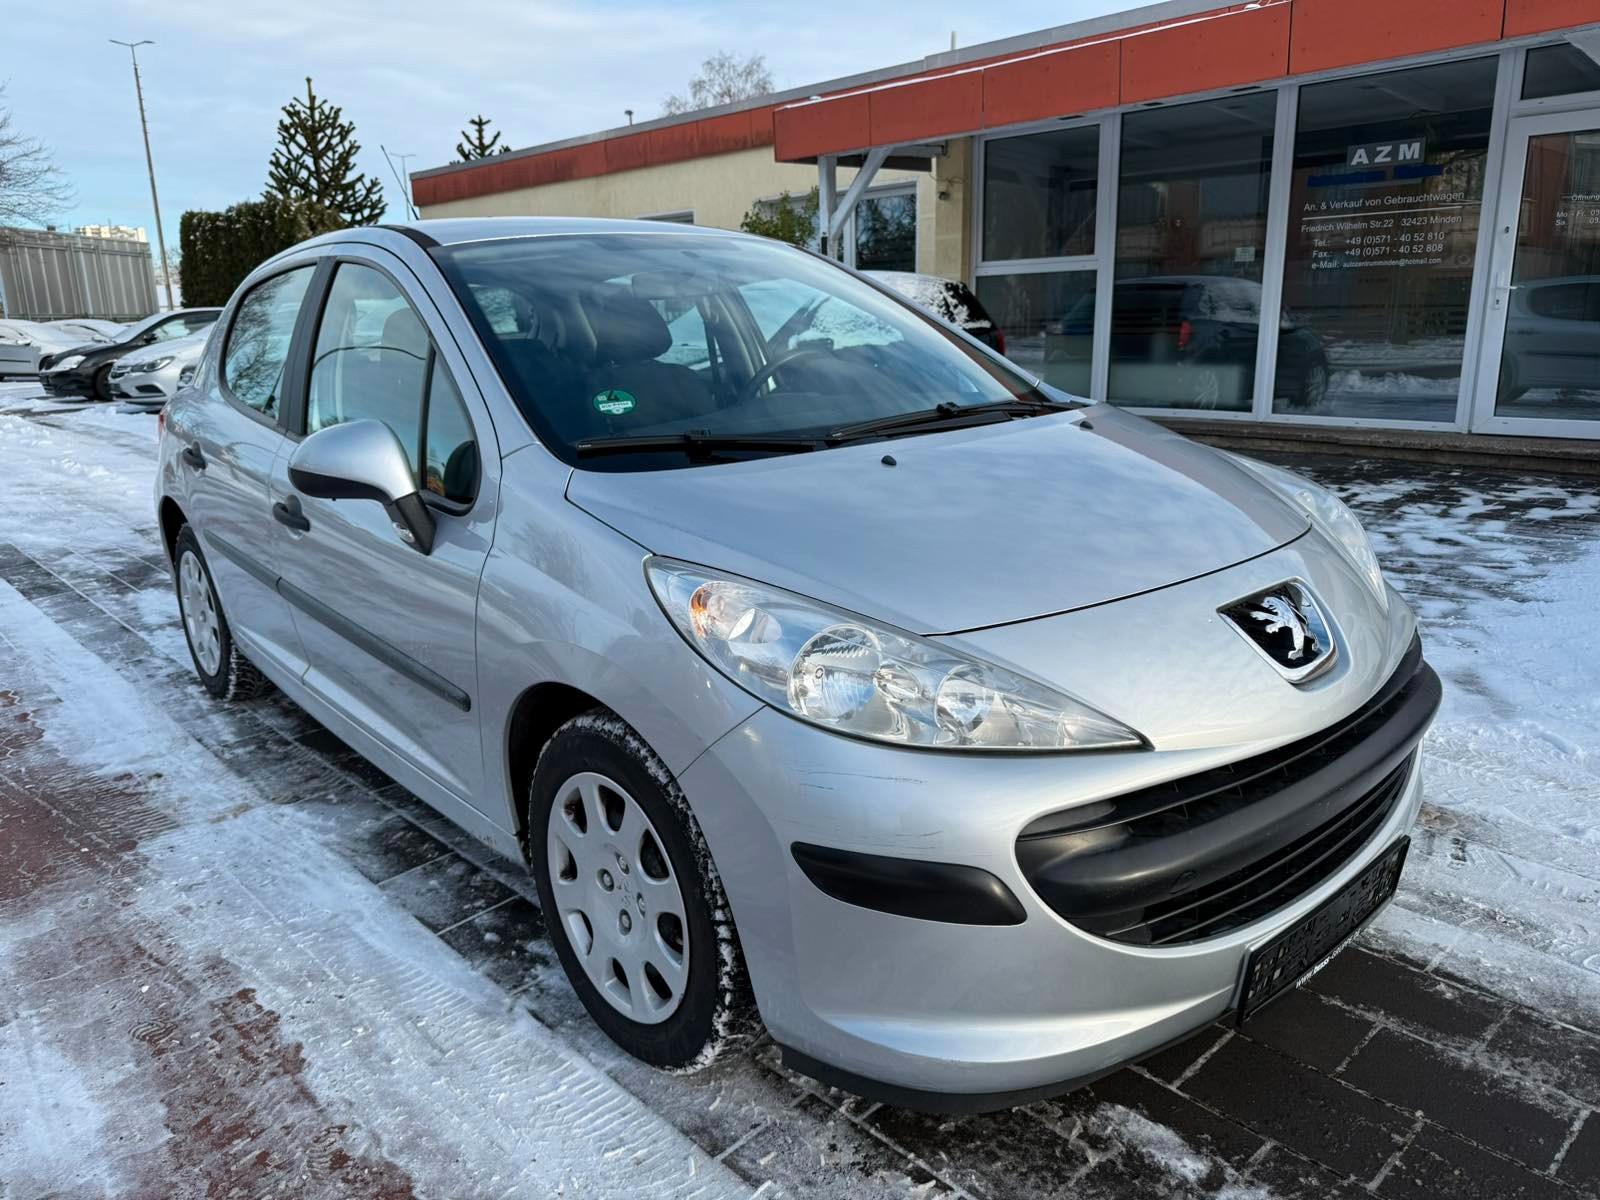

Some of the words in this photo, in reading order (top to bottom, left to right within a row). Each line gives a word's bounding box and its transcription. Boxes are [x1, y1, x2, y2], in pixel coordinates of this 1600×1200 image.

[1320, 202, 1327, 210] &
[1329, 199, 1363, 209] Verkauf
[1384, 191, 1465, 205] Gebrauchtwagen
[1301, 223, 1334, 233] Friedrich
[1336, 221, 1368, 231] Wilhelm
[1369, 219, 1394, 229] Str.22
[1400, 216, 1428, 227] 32423
[1429, 215, 1463, 225] Minden
[1345, 236, 1361, 245] +49
[1363, 235, 1391, 246] (0)571
[1399, 233, 1411, 242] 40
[1413, 232, 1425, 242] 52
[1427, 231, 1445, 241] 810
[1344, 247, 1361, 256] +49
[1362, 246, 1390, 257] (0)571
[1398, 245, 1410, 254] 40
[1412, 244, 1424, 253] 52
[1426, 243, 1444, 252] 808
